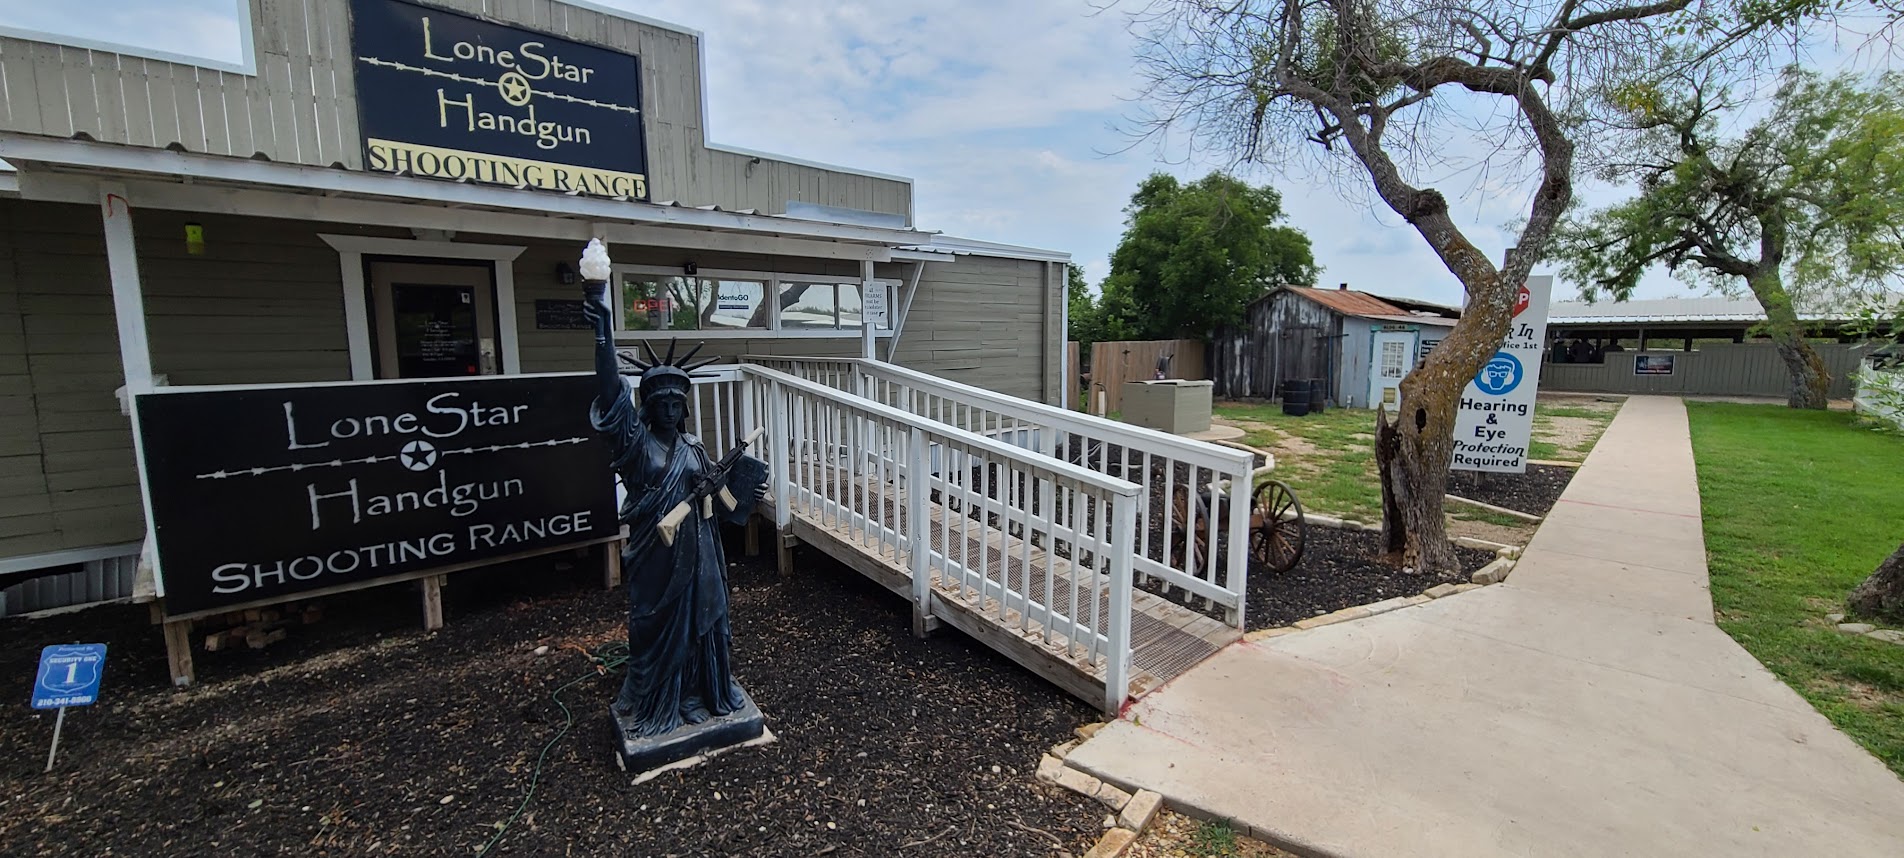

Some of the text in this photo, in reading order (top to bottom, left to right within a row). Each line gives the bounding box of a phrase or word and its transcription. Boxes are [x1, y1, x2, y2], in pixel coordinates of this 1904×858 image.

[437, 89, 591, 150] Handgun
[369, 145, 647, 198] SHOOTING RANGE
[1518, 323, 1534, 340] In
[1502, 341, 1538, 350] fice 1st
[1460, 398, 1528, 416] Hearing
[1485, 413, 1498, 425] &
[1474, 425, 1507, 441] Eye
[1453, 440, 1525, 458] Protection
[1454, 453, 1519, 468] Required
[307, 469, 524, 530] Handgun
[211, 510, 593, 594] SHOOTING RANGE
[62, 661, 77, 684] 1
